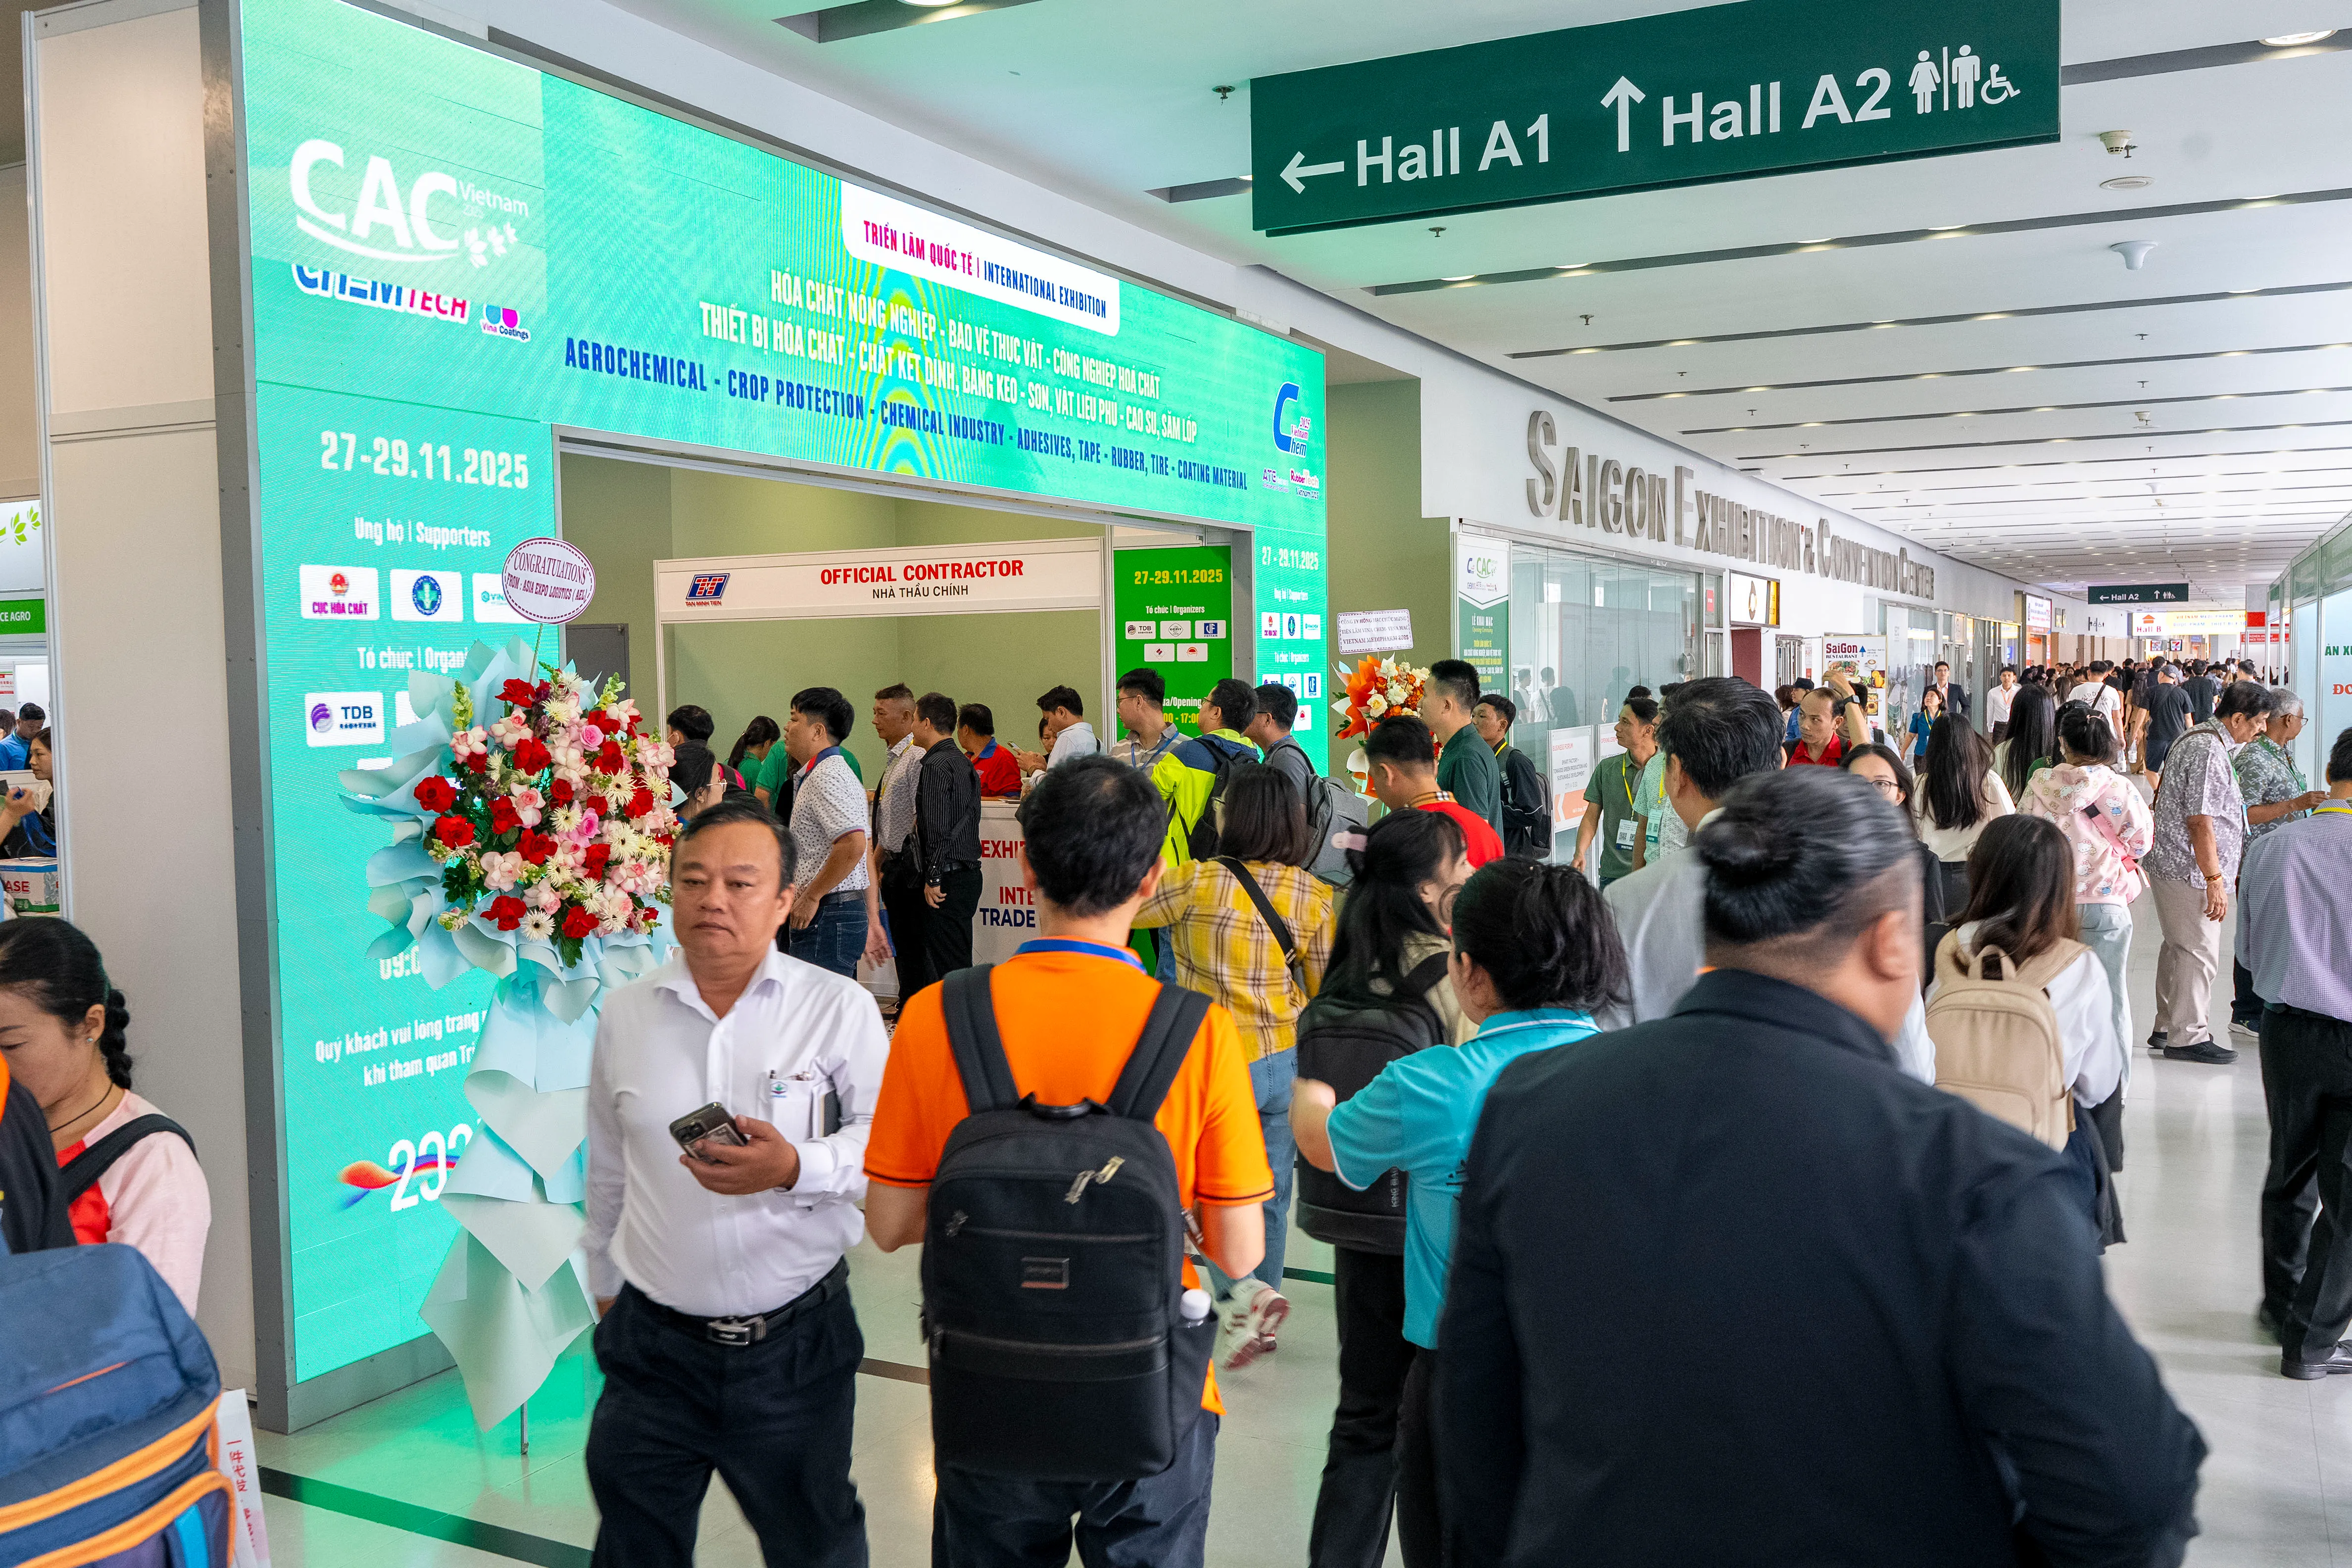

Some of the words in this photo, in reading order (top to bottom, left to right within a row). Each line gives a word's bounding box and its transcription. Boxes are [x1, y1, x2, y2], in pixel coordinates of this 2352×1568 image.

[1662, 83, 1781, 147] Hall
[1802, 67, 1892, 130] A2
[1355, 128, 1461, 187] Hall
[1478, 113, 1550, 171] A1
[290, 139, 458, 248] CAC
[459, 180, 528, 217] Vietnam
[864, 220, 896, 252] TRIỂN
[903, 232, 925, 261] LÃM
[930, 243, 957, 271] QUỐC
[961, 251, 973, 276] TẾ
[984, 260, 1056, 302] INTERNATIONAL
[1060, 286, 1106, 319] EXHIBITION
[483, 322, 497, 333] Vina
[499, 325, 529, 341] Coatings
[772, 267, 803, 309] HÓA
[806, 279, 844, 319] CHẤT
[848, 289, 886, 330] NÔNG
[890, 302, 936, 345] NGHIỆP
[949, 315, 972, 352] BẢO
[975, 324, 989, 361] VỆ
[992, 331, 1021, 368] THỰC
[1023, 338, 1044, 373] VẬT
[1053, 345, 1080, 380] CÔNG
[1083, 357, 1116, 392] NGHIỆP
[1138, 370, 1160, 400] CHẤT
[699, 301, 747, 344] THIẾT
[752, 314, 768, 355] BỊ
[773, 317, 805, 358] HÓA
[859, 339, 894, 377] CHẤT
[898, 347, 921, 384] KẾT
[925, 353, 960, 397] DÍNH,
[963, 361, 993, 400] BĂNG
[996, 373, 1018, 404] KEO
[1028, 380, 1053, 418] SƠN,
[1055, 386, 1074, 420] VẬT
[1077, 391, 1097, 425] LIỆU
[1098, 394, 1118, 427] PHỦ
[1126, 405, 1143, 433] CAO
[1145, 409, 1160, 441] SU,
[1162, 410, 1180, 441] SĂM
[1182, 414, 1197, 443] LỐP
[565, 337, 707, 392] AGROCHEMICAL
[729, 369, 769, 403] CROP
[777, 379, 864, 421] PROTECTION
[882, 400, 944, 436] CHEMICAL
[949, 414, 1004, 445] INDUSTRY
[1018, 428, 1075, 463] ADHESIVES,
[1078, 439, 1100, 464] TAPE
[1112, 446, 1148, 476] RUBBER,
[1151, 453, 1169, 476] TIRE
[1178, 460, 1210, 484] COATING
[1213, 467, 1247, 490] MATERIAL
[1300, 417, 1310, 429] 2025
[1291, 425, 1308, 440] Vietnam
[321, 431, 529, 489] 27-29.11.2025
[1263, 468, 1276, 483] ATE
[1527, 410, 1667, 542] SAIGON
[1675, 465, 1801, 571] EXHIBITION
[1804, 527, 1815, 574] &
[1817, 518, 1899, 592] CONVENTION
[1899, 547, 1935, 600] CENTER
[387, 518, 404, 545] hộ
[416, 521, 490, 550] Supporters
[513, 552, 588, 585] CONGRATULATIONS
[821, 566, 897, 585] OFFICIAL
[903, 560, 1024, 582] CONTRACTOR
[1134, 569, 1223, 585] 27-29.11.2025
[1476, 557, 1491, 576] CAC
[506, 572, 520, 589] FROM
[523, 580, 534, 593] ASIA
[535, 583, 548, 596] EXPO
[549, 586, 572, 600] LOGISTICS
[873, 585, 896, 599] NHÀ
[899, 583, 930, 597] THẦU
[933, 583, 969, 596] CHÍNH
[2111, 593, 2127, 601] Hall
[0, 612, 8, 622] CE
[10, 611, 31, 622] AGRO
[1154, 605, 1169, 614] chức
[1173, 605, 1205, 616] Organizers
[1826, 643, 1858, 653] SaiGon
[2343, 646, 2352, 655] X
[380, 646, 413, 669] chức
[425, 648, 468, 674] Organi
[341, 705, 373, 720] TDB
[5, 881, 30, 892] ASE
[999, 886, 1036, 905] INTE
[979, 907, 1036, 928] TRADE
[315, 1037, 342, 1063] Quý
[346, 1027, 388, 1056] khách
[392, 1021, 412, 1046] vui
[445, 1011, 479, 1034] trang
[364, 1062, 386, 1086] khi
[390, 1057, 423, 1082] tham
[426, 1051, 457, 1077] quan
